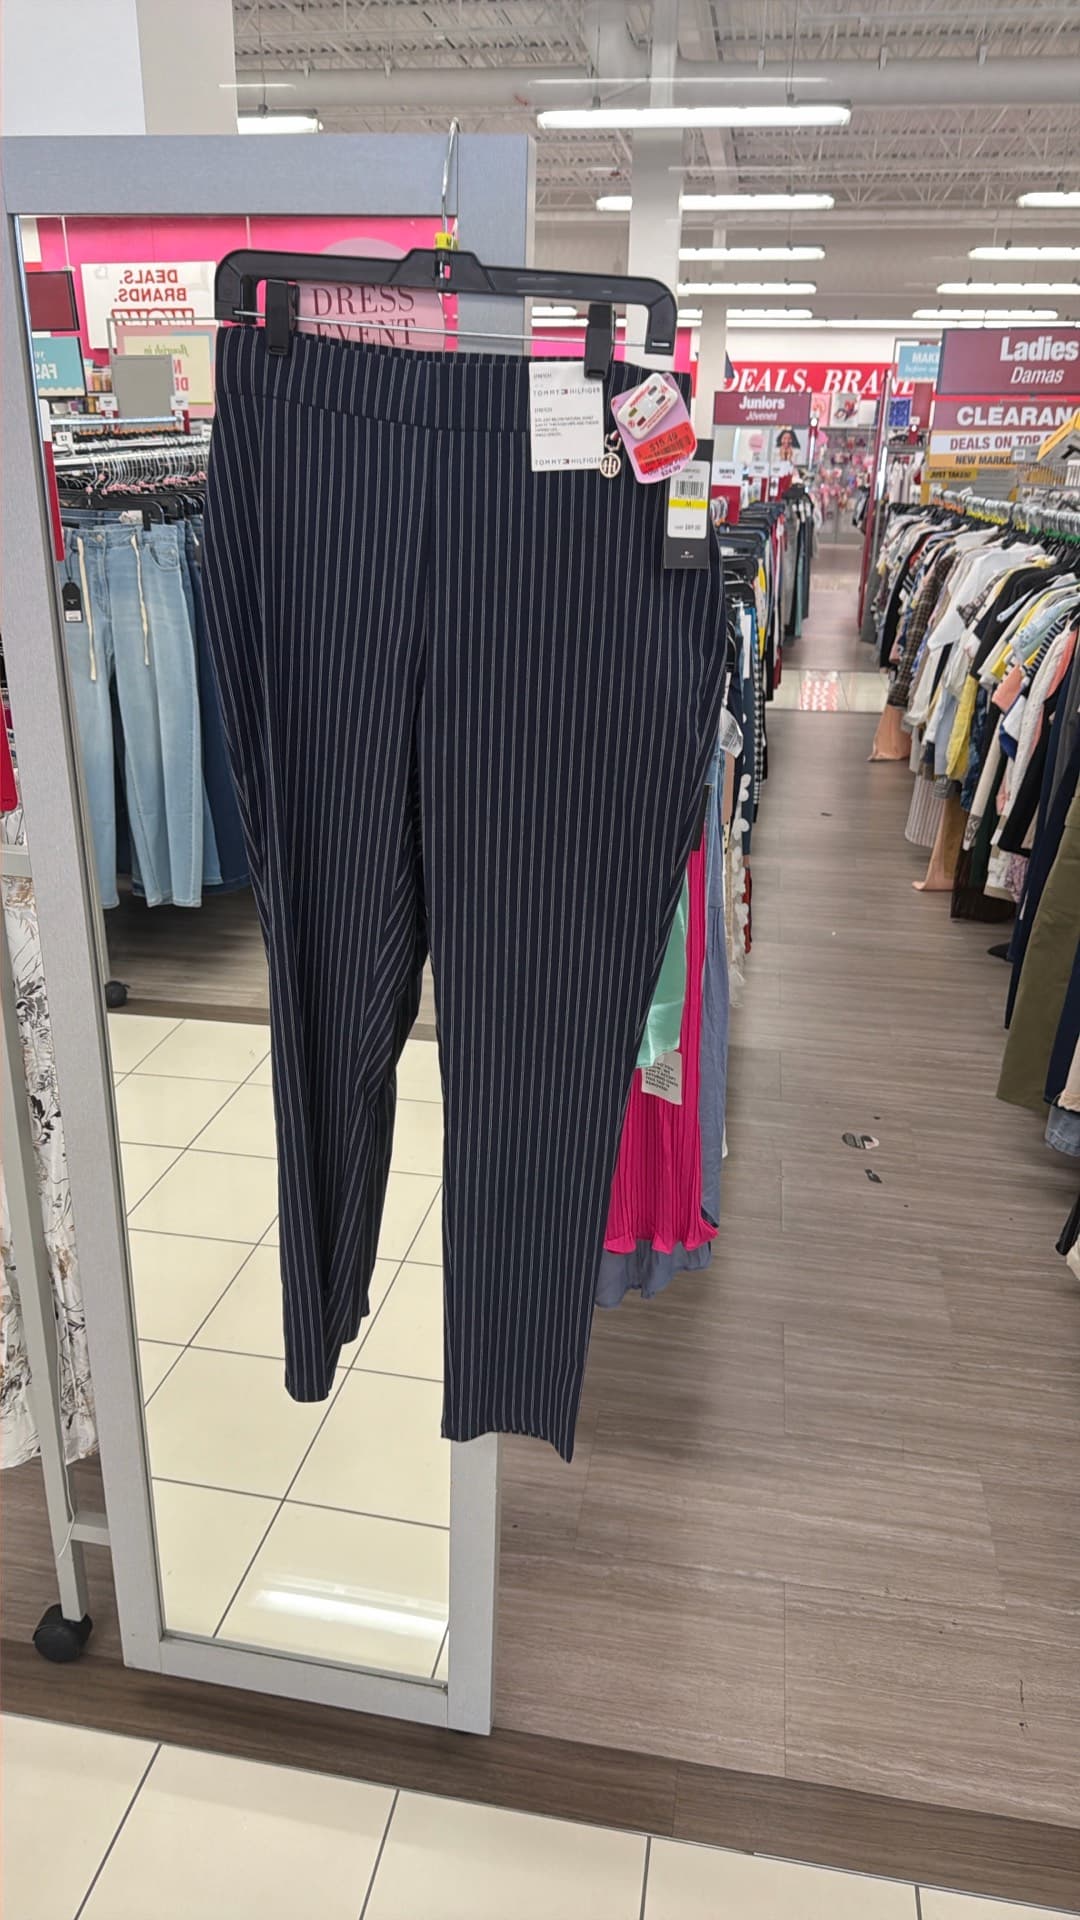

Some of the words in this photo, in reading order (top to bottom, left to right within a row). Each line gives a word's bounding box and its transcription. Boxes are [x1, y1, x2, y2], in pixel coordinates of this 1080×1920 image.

[312, 284, 415, 316] DRESS
[315, 318, 416, 346] EVENT
[1000, 336, 1080, 361] Ladies
[912, 351, 940, 363] MAK
[1010, 366, 1065, 384] Damas
[533, 388, 559, 397] TOMMY
[739, 395, 786, 410] Juniors
[950, 437, 990, 450] DEALS
[995, 436, 1012, 449] ON
[535, 458, 561, 466] TOMMY
[955, 455, 976, 465] NEW
